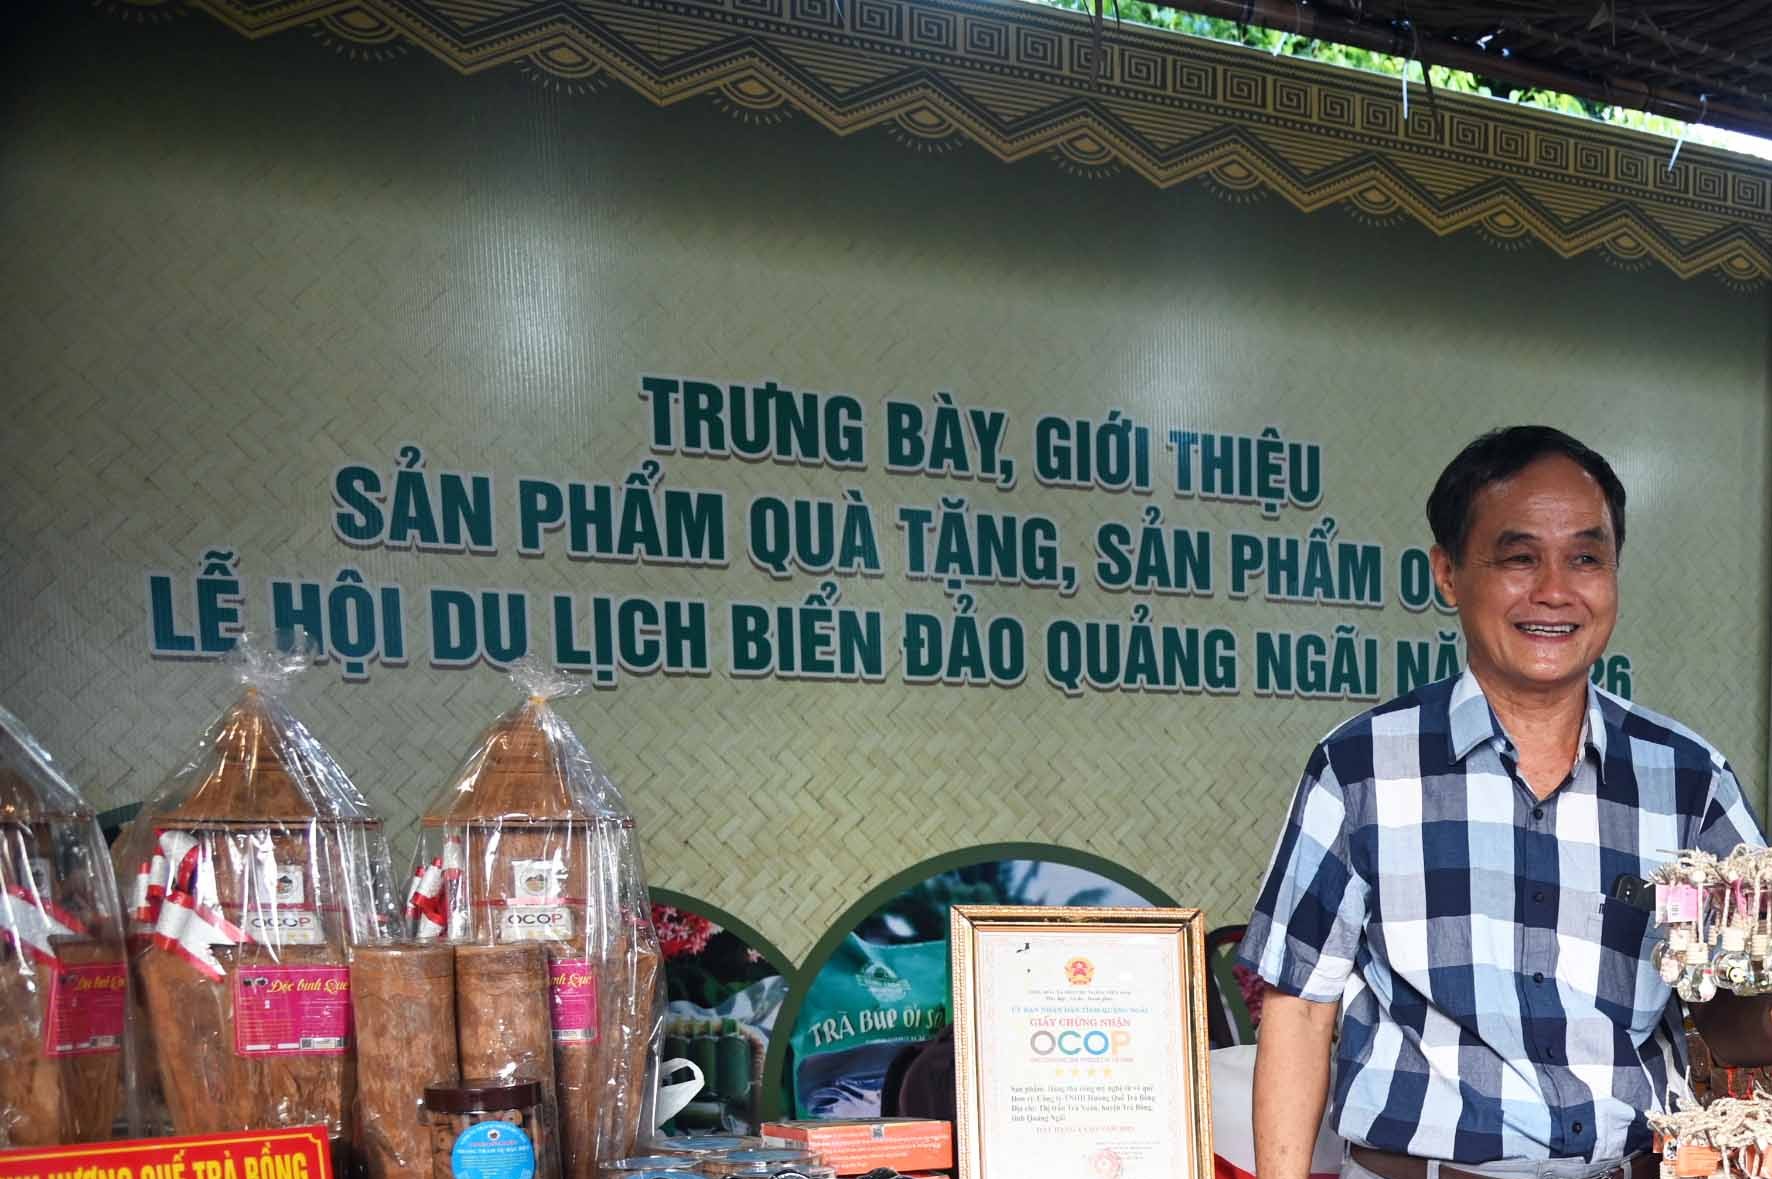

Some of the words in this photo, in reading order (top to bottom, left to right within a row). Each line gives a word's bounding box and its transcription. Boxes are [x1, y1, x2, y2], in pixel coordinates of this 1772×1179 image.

[641, 377, 863, 466] TRƯNG
[887, 393, 1014, 481] BÀY,
[1036, 411, 1150, 486] GIỚI
[1170, 428, 1320, 510] THIỆU
[336, 446, 492, 545] SẢN
[519, 460, 725, 562] PHẨM
[750, 490, 880, 573] QUÀ
[900, 497, 1076, 590] TẶNG,
[1098, 505, 1211, 590] SẢN
[1232, 517, 1382, 601] PHẨM
[150, 551, 240, 652] LỄ
[273, 569, 404, 674] HỘI
[431, 590, 527, 662] DU
[554, 596, 707, 683] LỊCH
[732, 582, 882, 677] BIỂN
[903, 594, 1025, 681] ĐẢO
[1047, 604, 1236, 690] QUẢNG
[1257, 625, 1378, 696] NGÃI
[1397, 632, 1464, 698] NĂ
[1030, 1030, 1131, 1056] OCOP
